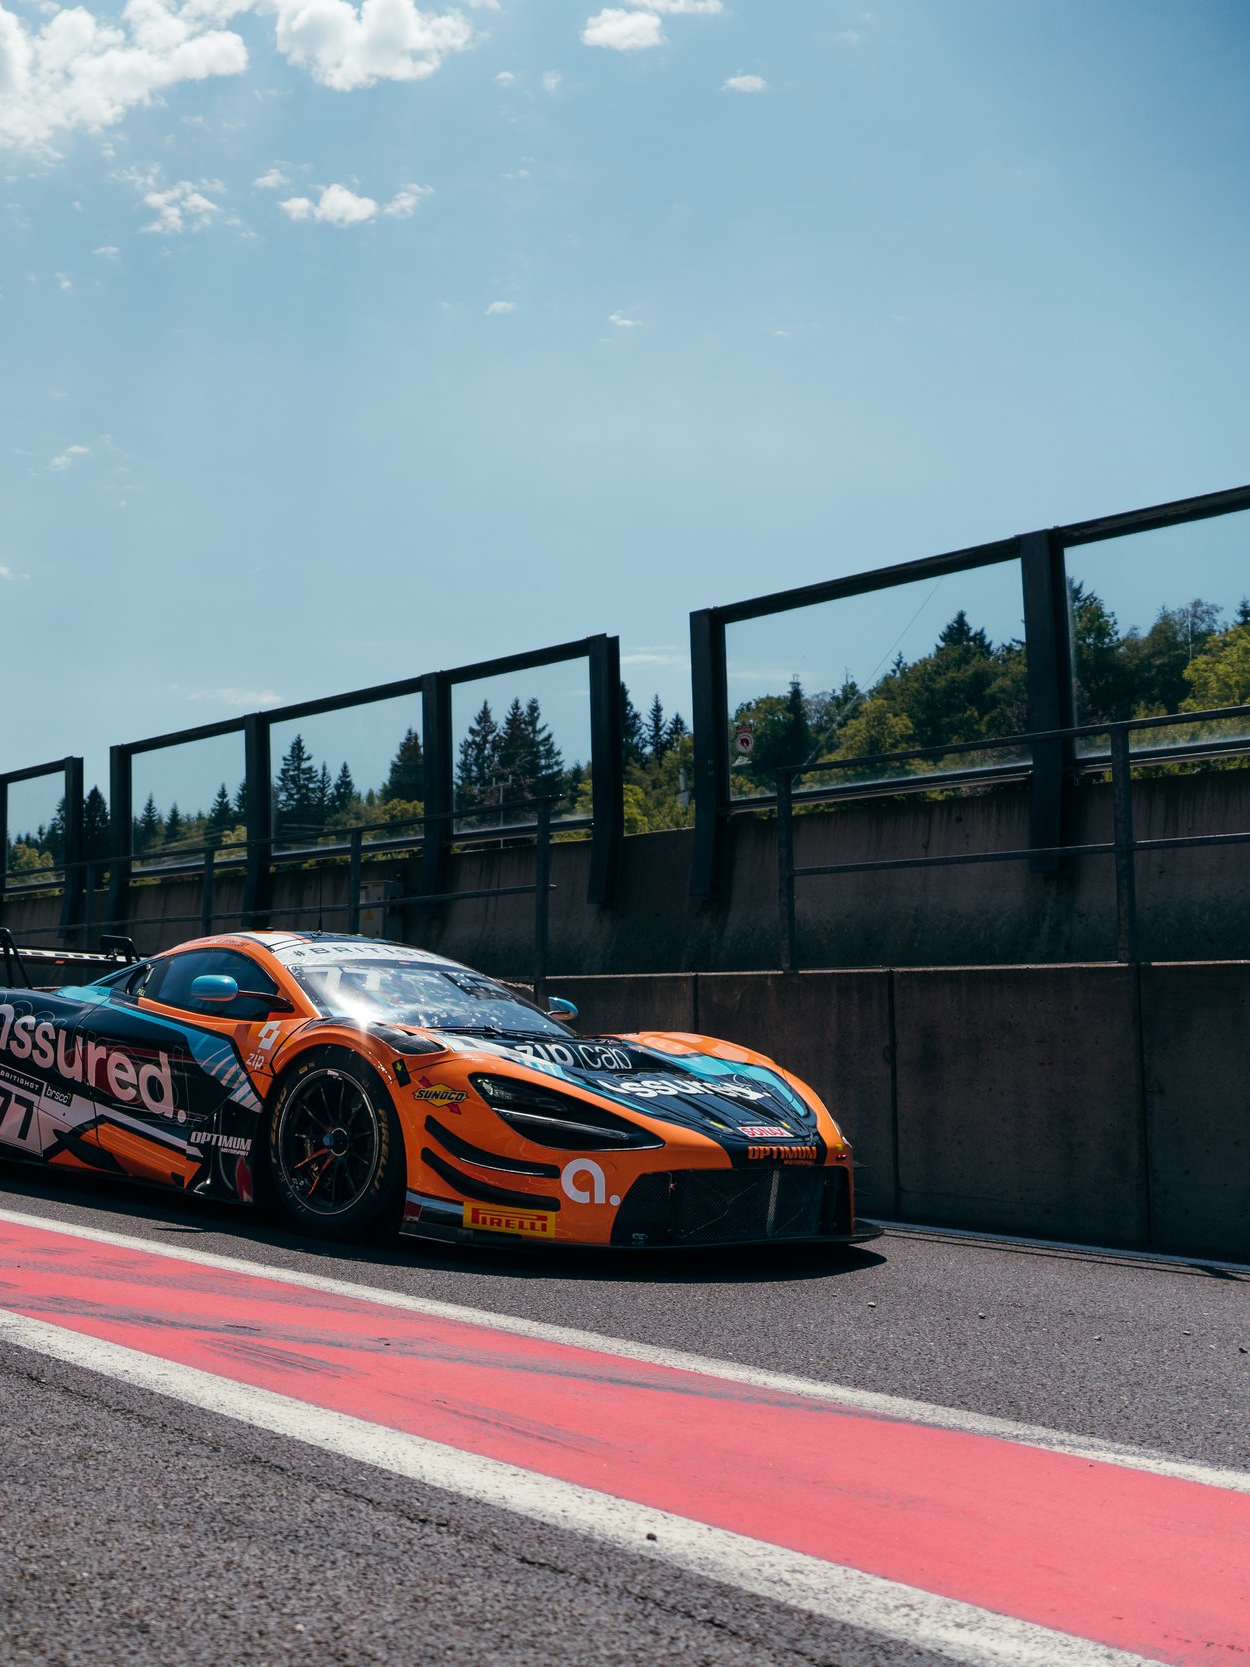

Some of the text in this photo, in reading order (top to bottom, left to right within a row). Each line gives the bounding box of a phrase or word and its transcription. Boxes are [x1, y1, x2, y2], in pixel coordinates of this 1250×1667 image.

[416, 1088, 465, 1102] SUNOCO
[741, 1127, 789, 1137] SONAX
[190, 1131, 252, 1151] OPTIMUM
[748, 1146, 817, 1160] OPTIMUM
[471, 1207, 548, 1233] PIRELLI
